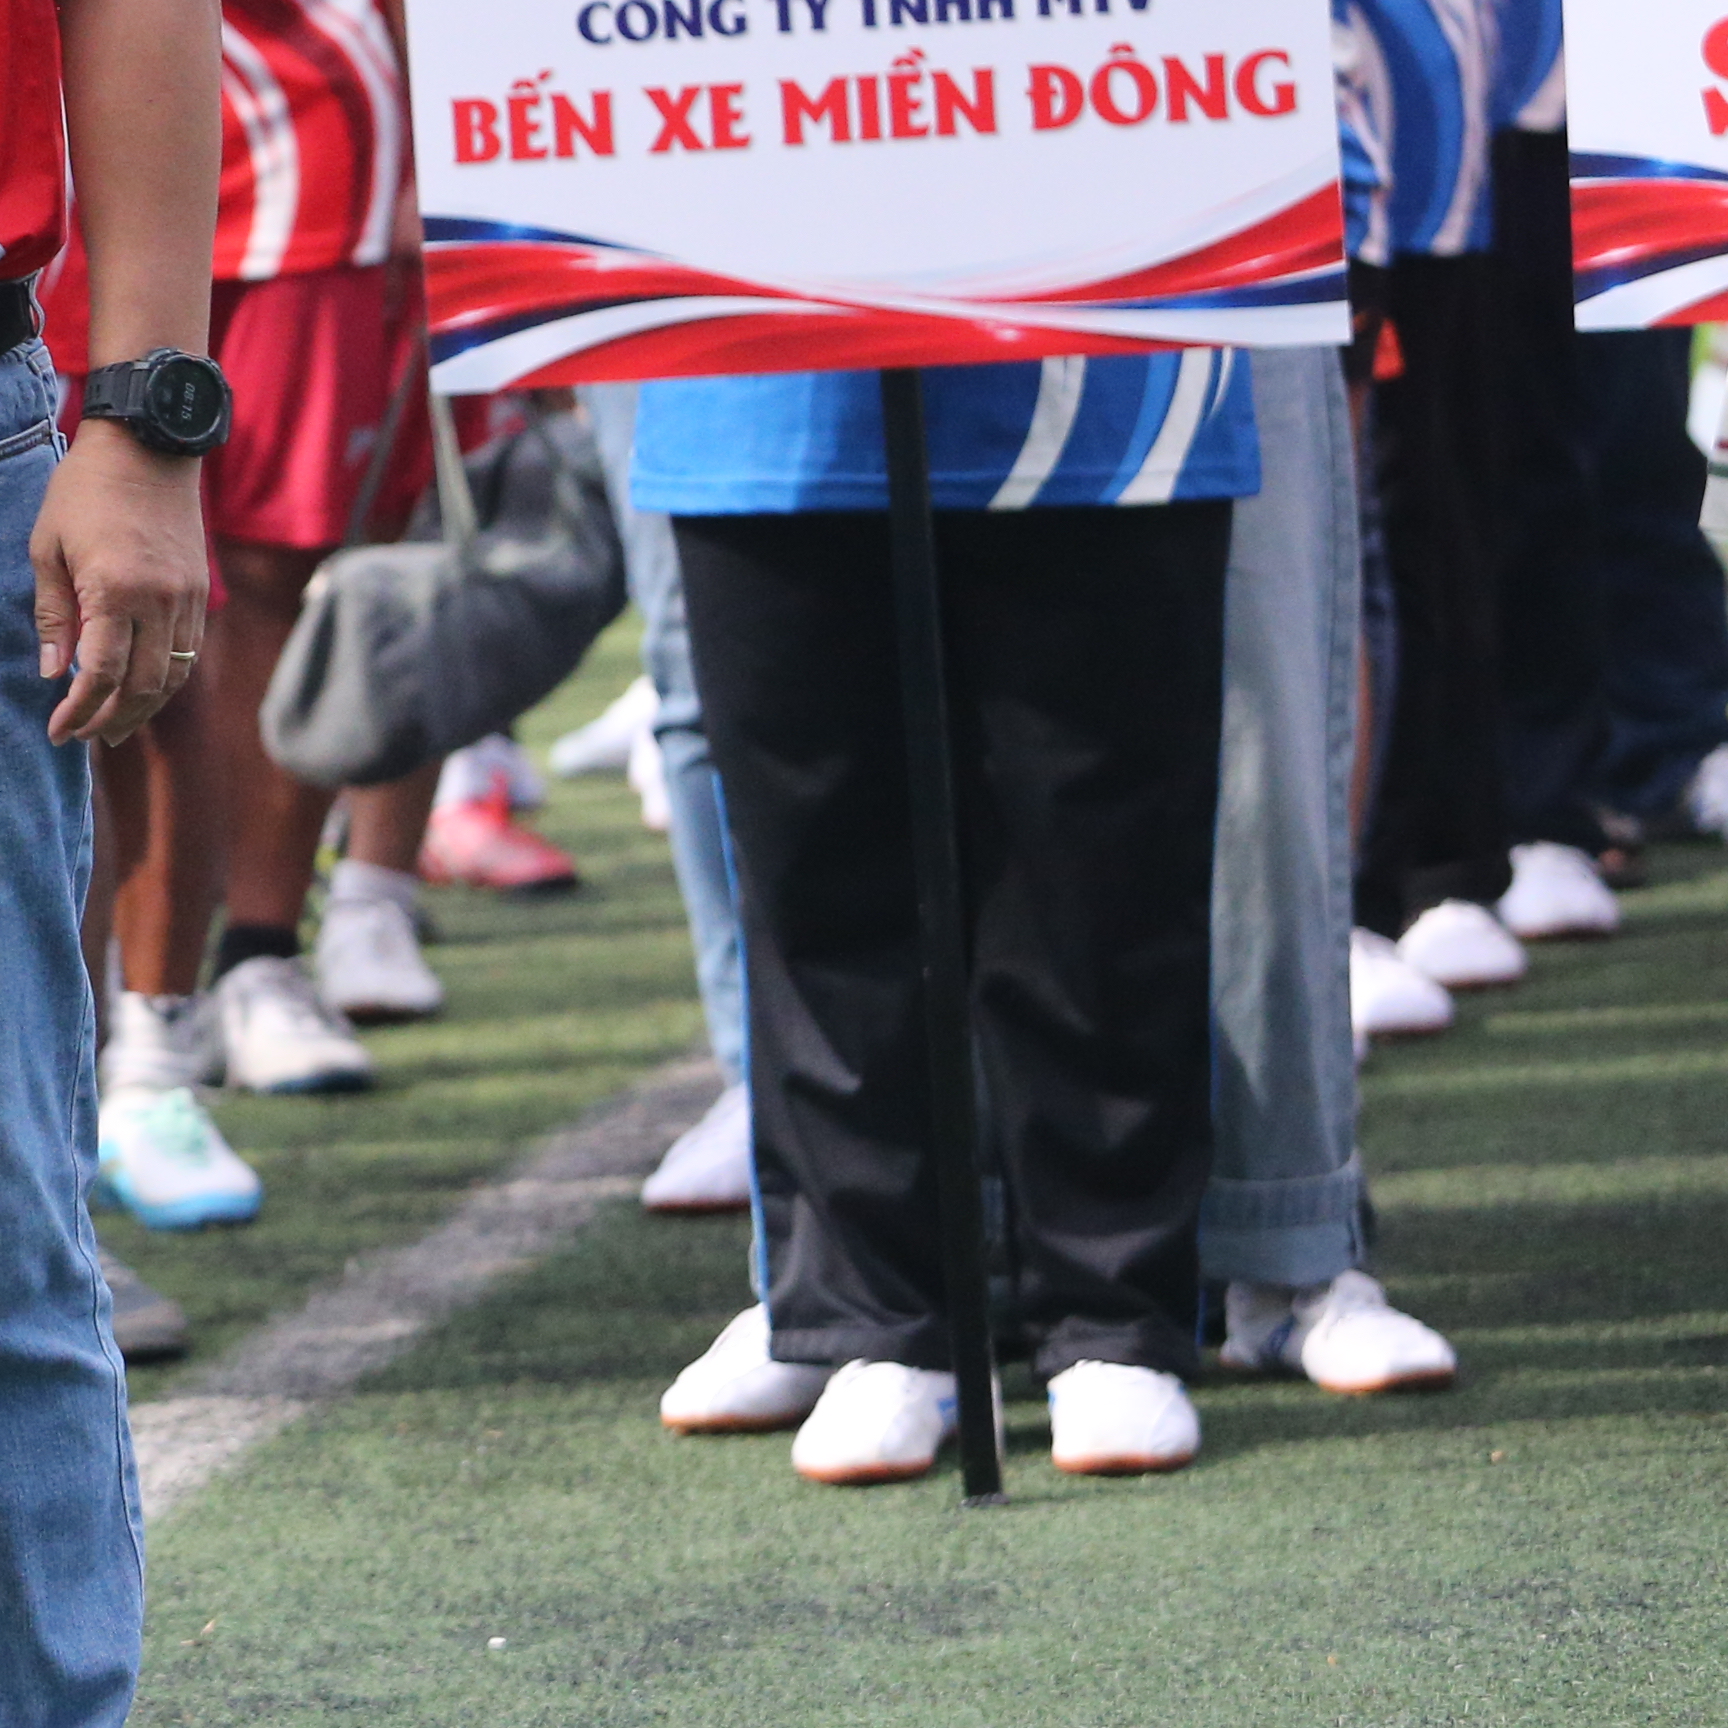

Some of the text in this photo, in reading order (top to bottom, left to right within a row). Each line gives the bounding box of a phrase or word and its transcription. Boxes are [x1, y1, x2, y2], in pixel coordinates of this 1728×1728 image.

[450, 42, 1298, 164] BẾN XE MIỀN ĐÔNG
[180, 382, 196, 421] 08:15
